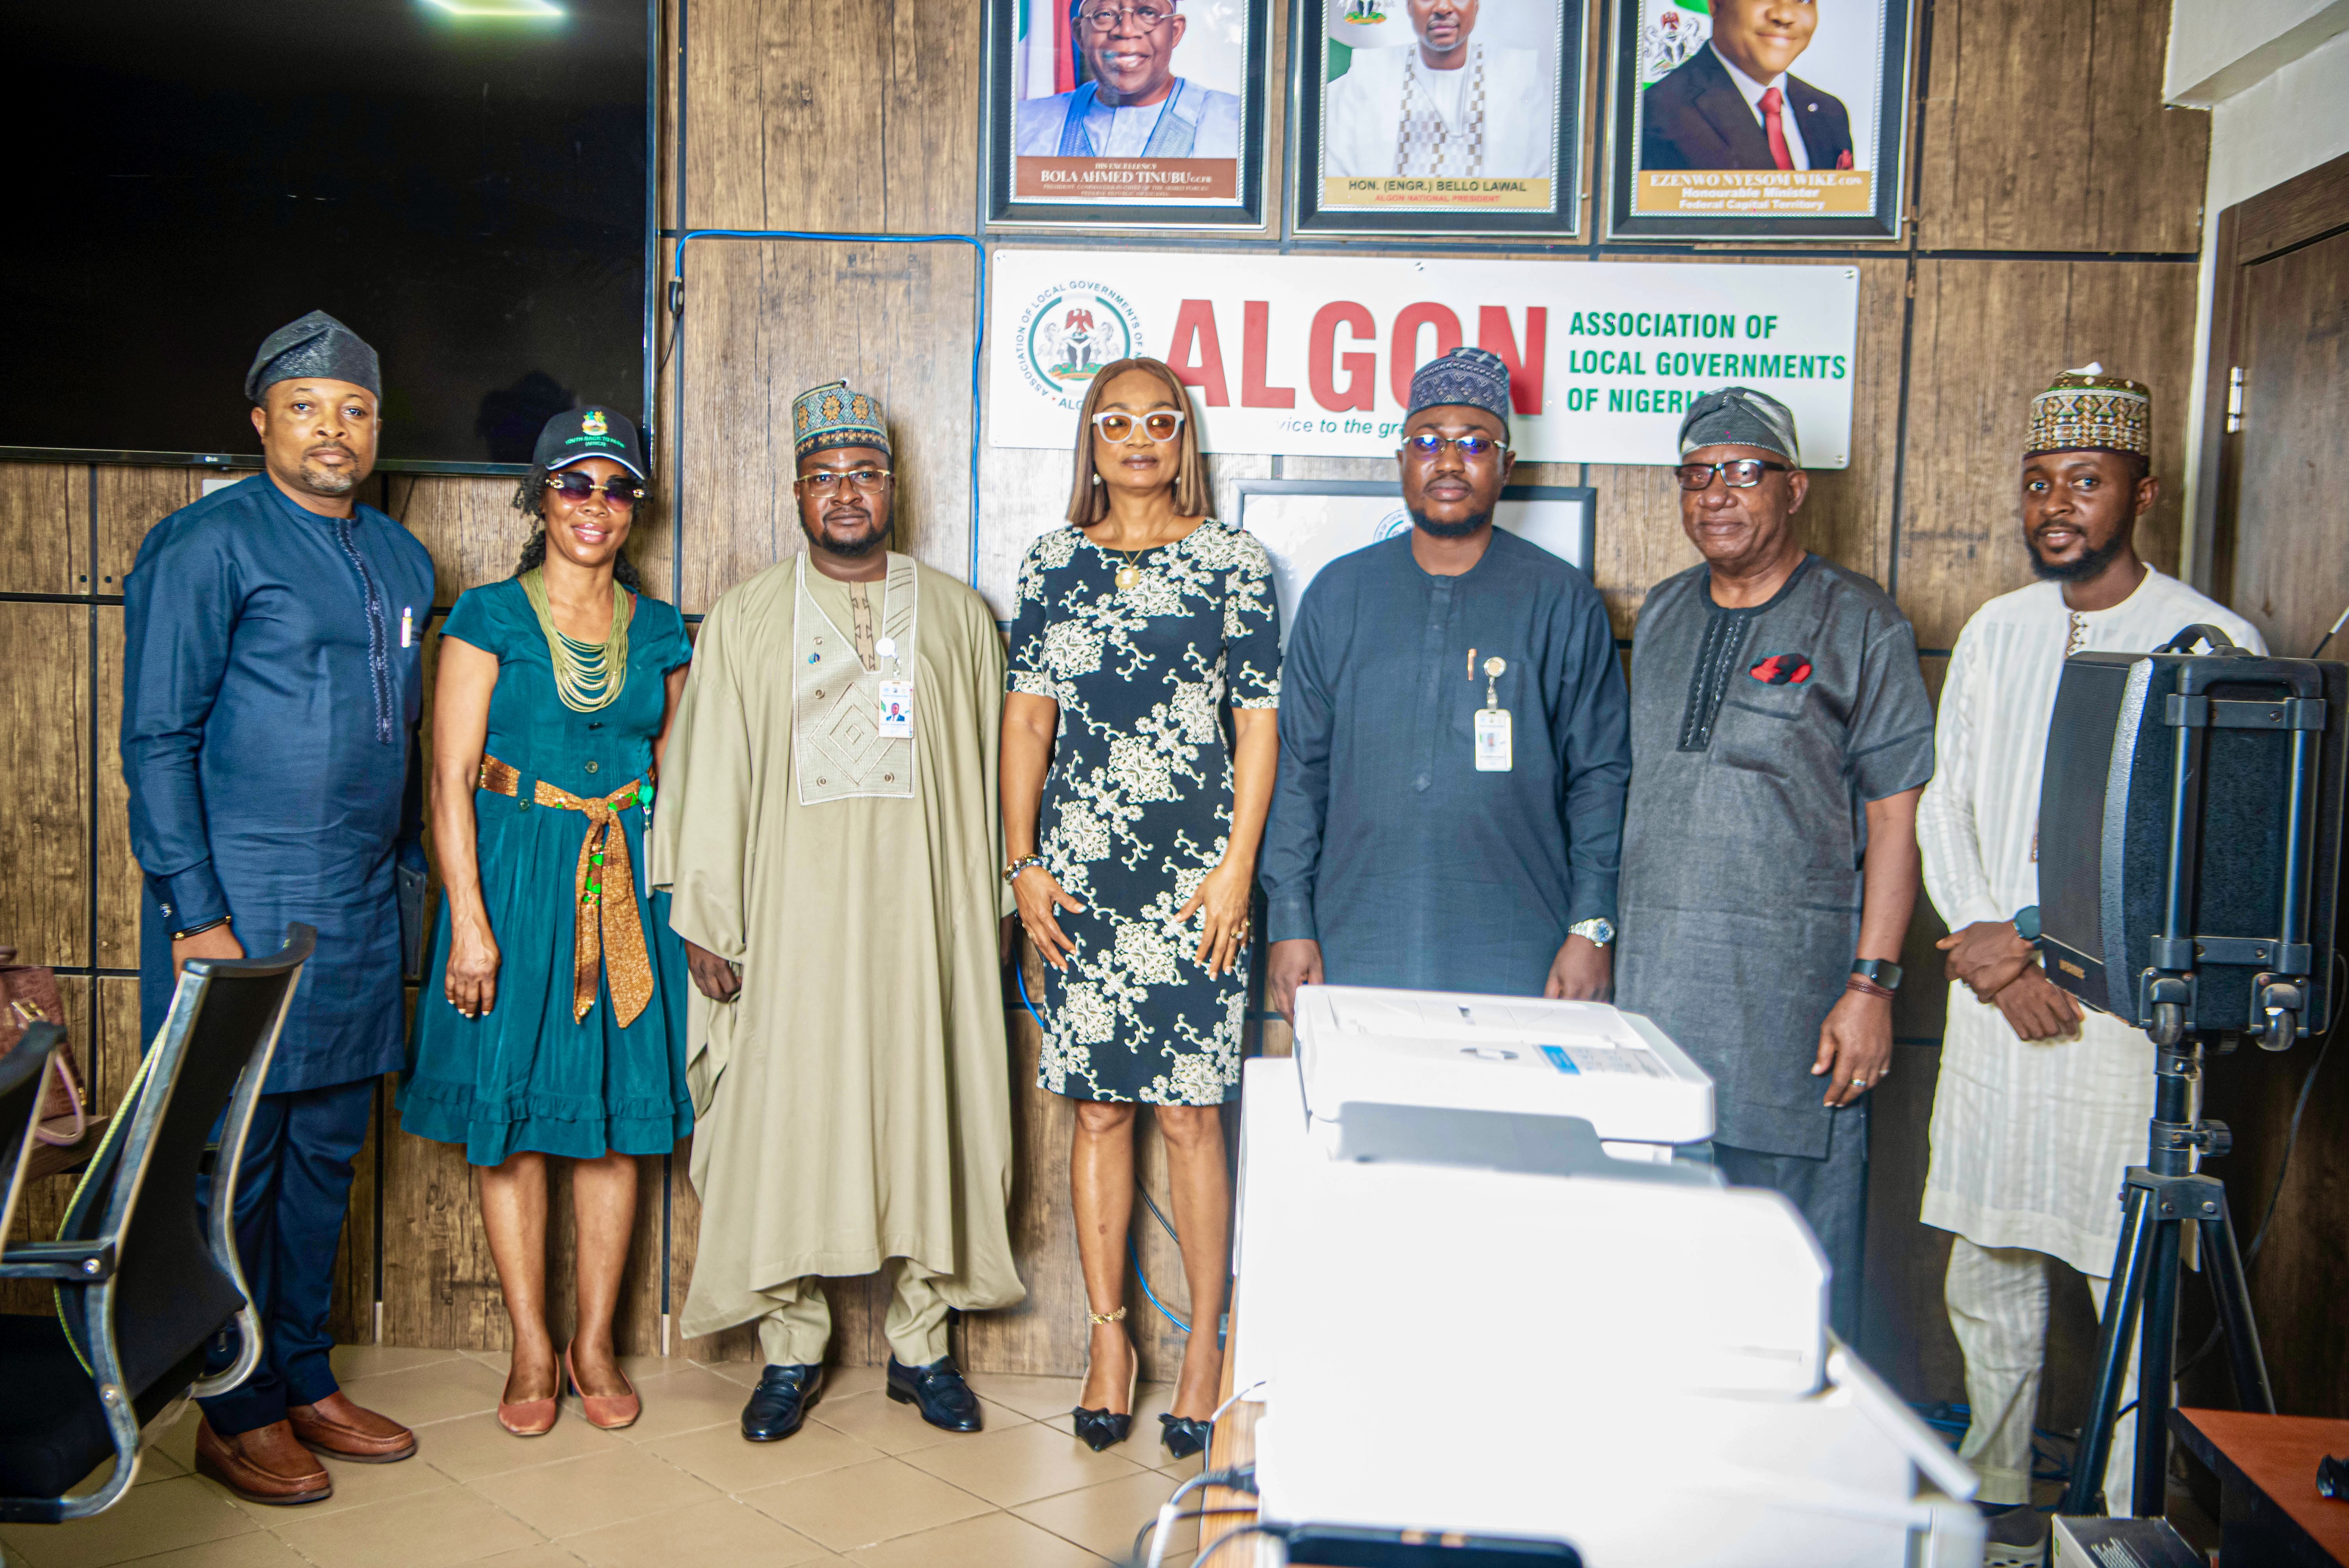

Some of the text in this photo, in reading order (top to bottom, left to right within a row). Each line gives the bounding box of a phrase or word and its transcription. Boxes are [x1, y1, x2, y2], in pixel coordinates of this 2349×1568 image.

[1041, 170, 1078, 182] BOLA
[1080, 171, 1134, 183] AHMED
[1135, 171, 1191, 184] TINUBU
[1650, 174, 1720, 187] EZENWO
[1722, 173, 1790, 186] NYESOM
[1793, 173, 1837, 186] WIKE
[1348, 180, 1527, 192] HON. (ENGR.) BELLO LAWAL
[1681, 187, 1820, 198] Honourable Minister
[1679, 199, 1825, 211] Federal Capital Territory
[1568, 311, 1778, 339] ASSOCIATION OF
[1016, 281, 1142, 396] ASSOCIATION OF LOCAL GOVERNMENTS OF
[1164, 299, 1547, 415] ALGON
[1569, 350, 1846, 380] LOCAL GOVERNMENTS
[1567, 388, 1599, 412] OF
[1319, 419, 1337, 433] to
[1344, 419, 1372, 434] the
